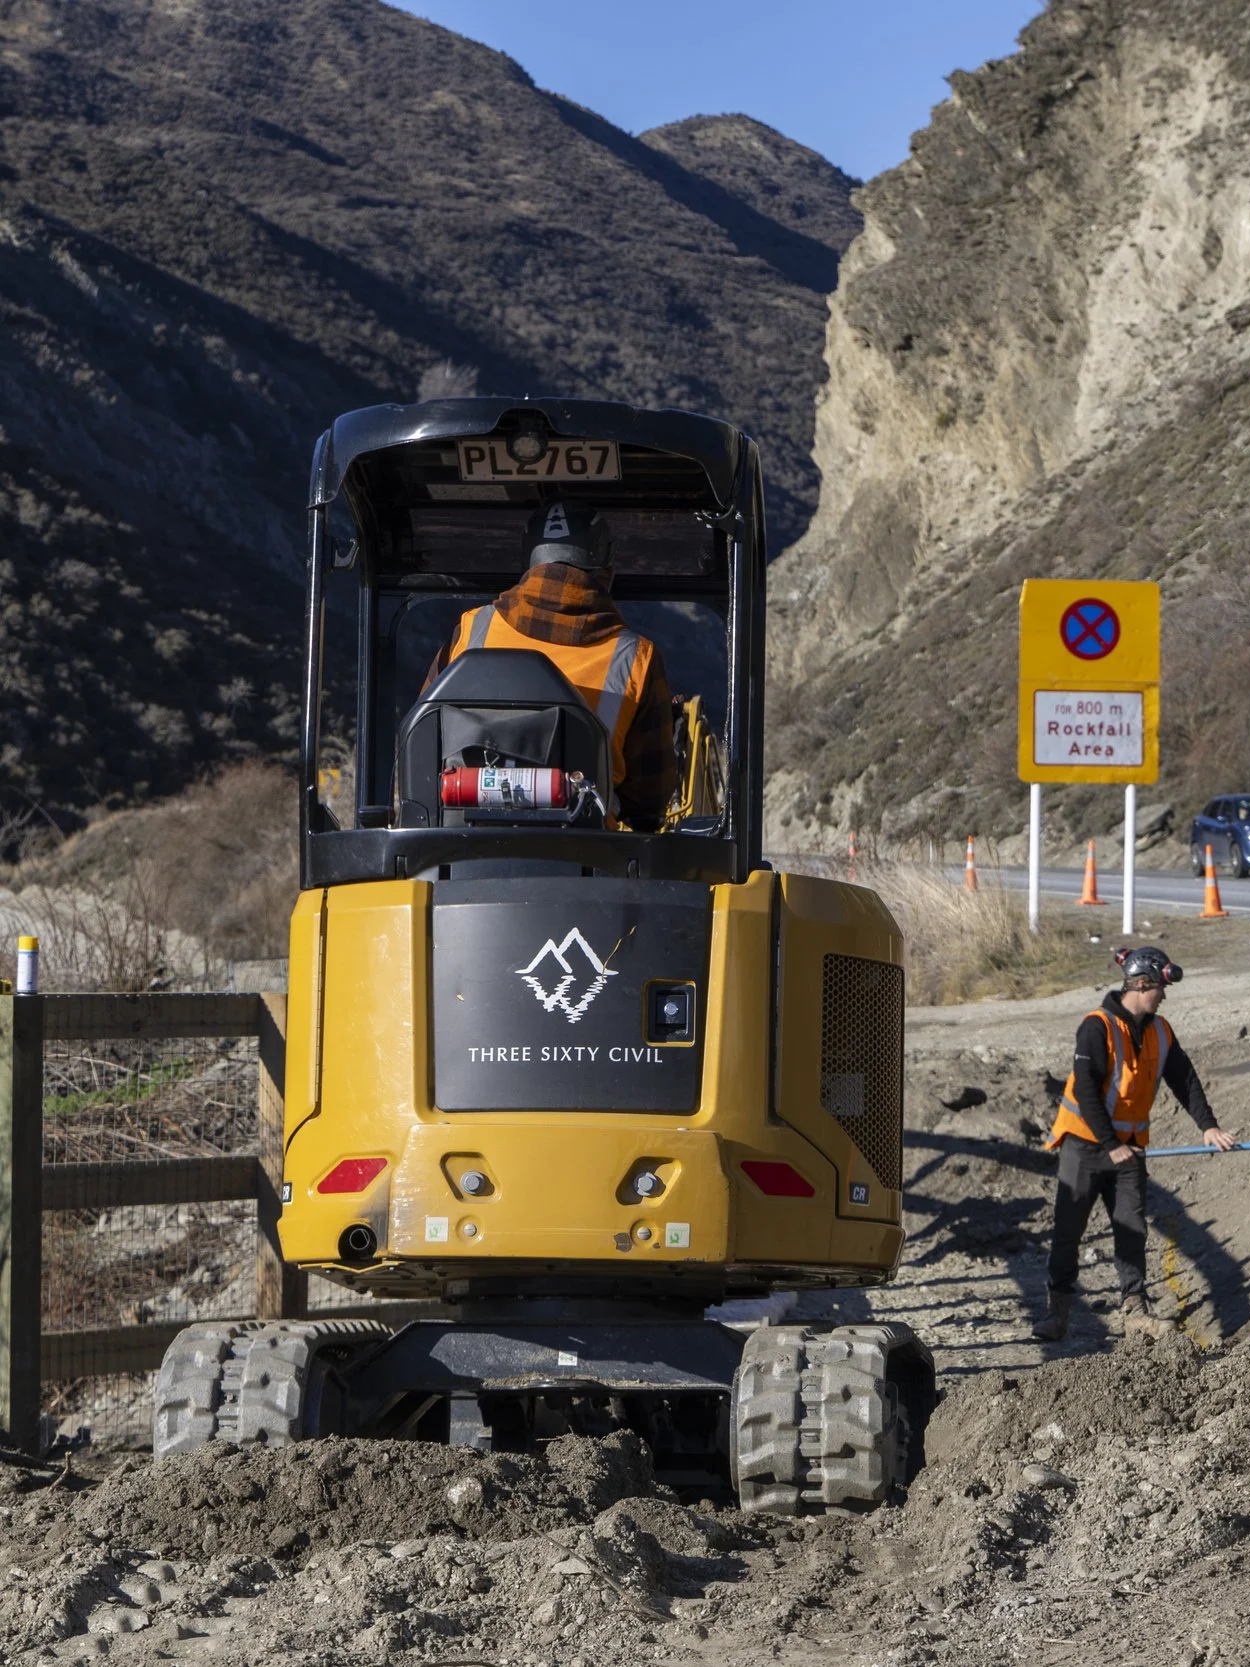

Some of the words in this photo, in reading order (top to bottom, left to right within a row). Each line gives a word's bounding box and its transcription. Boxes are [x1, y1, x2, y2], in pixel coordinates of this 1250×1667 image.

[1055, 704, 1072, 714] FOR
[1076, 700, 1103, 715] 800
[1109, 704, 1123, 715] m
[1047, 721, 1131, 737] Rockfall
[1068, 741, 1114, 756] Area
[468, 1047, 531, 1062] THREE
[540, 1046, 600, 1062] SIXTY
[608, 1047, 663, 1063] CIVIL
[852, 1186, 866, 1201] CR
